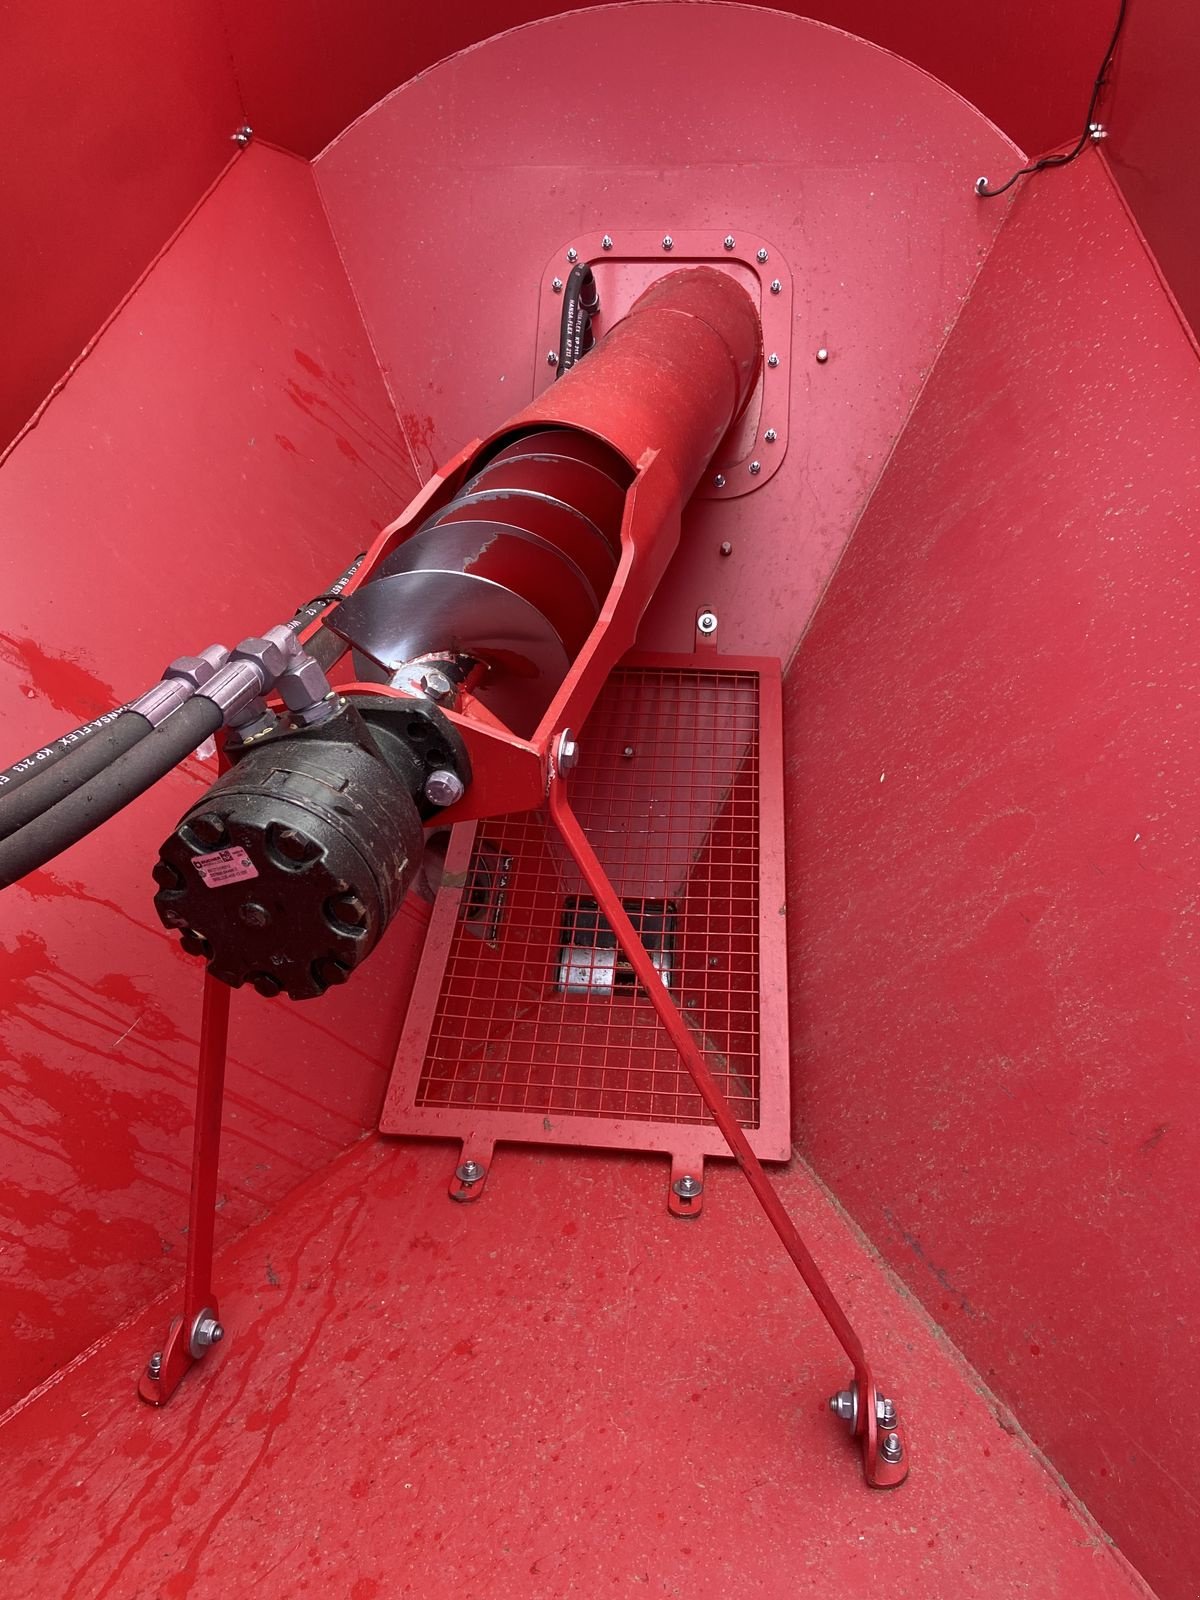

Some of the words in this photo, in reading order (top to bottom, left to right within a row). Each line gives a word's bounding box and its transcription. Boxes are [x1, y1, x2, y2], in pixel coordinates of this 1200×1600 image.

[566, 299, 575, 335] HANSA-FLEX
[35, 747, 54, 760] KP
[12, 758, 35, 772] 213
